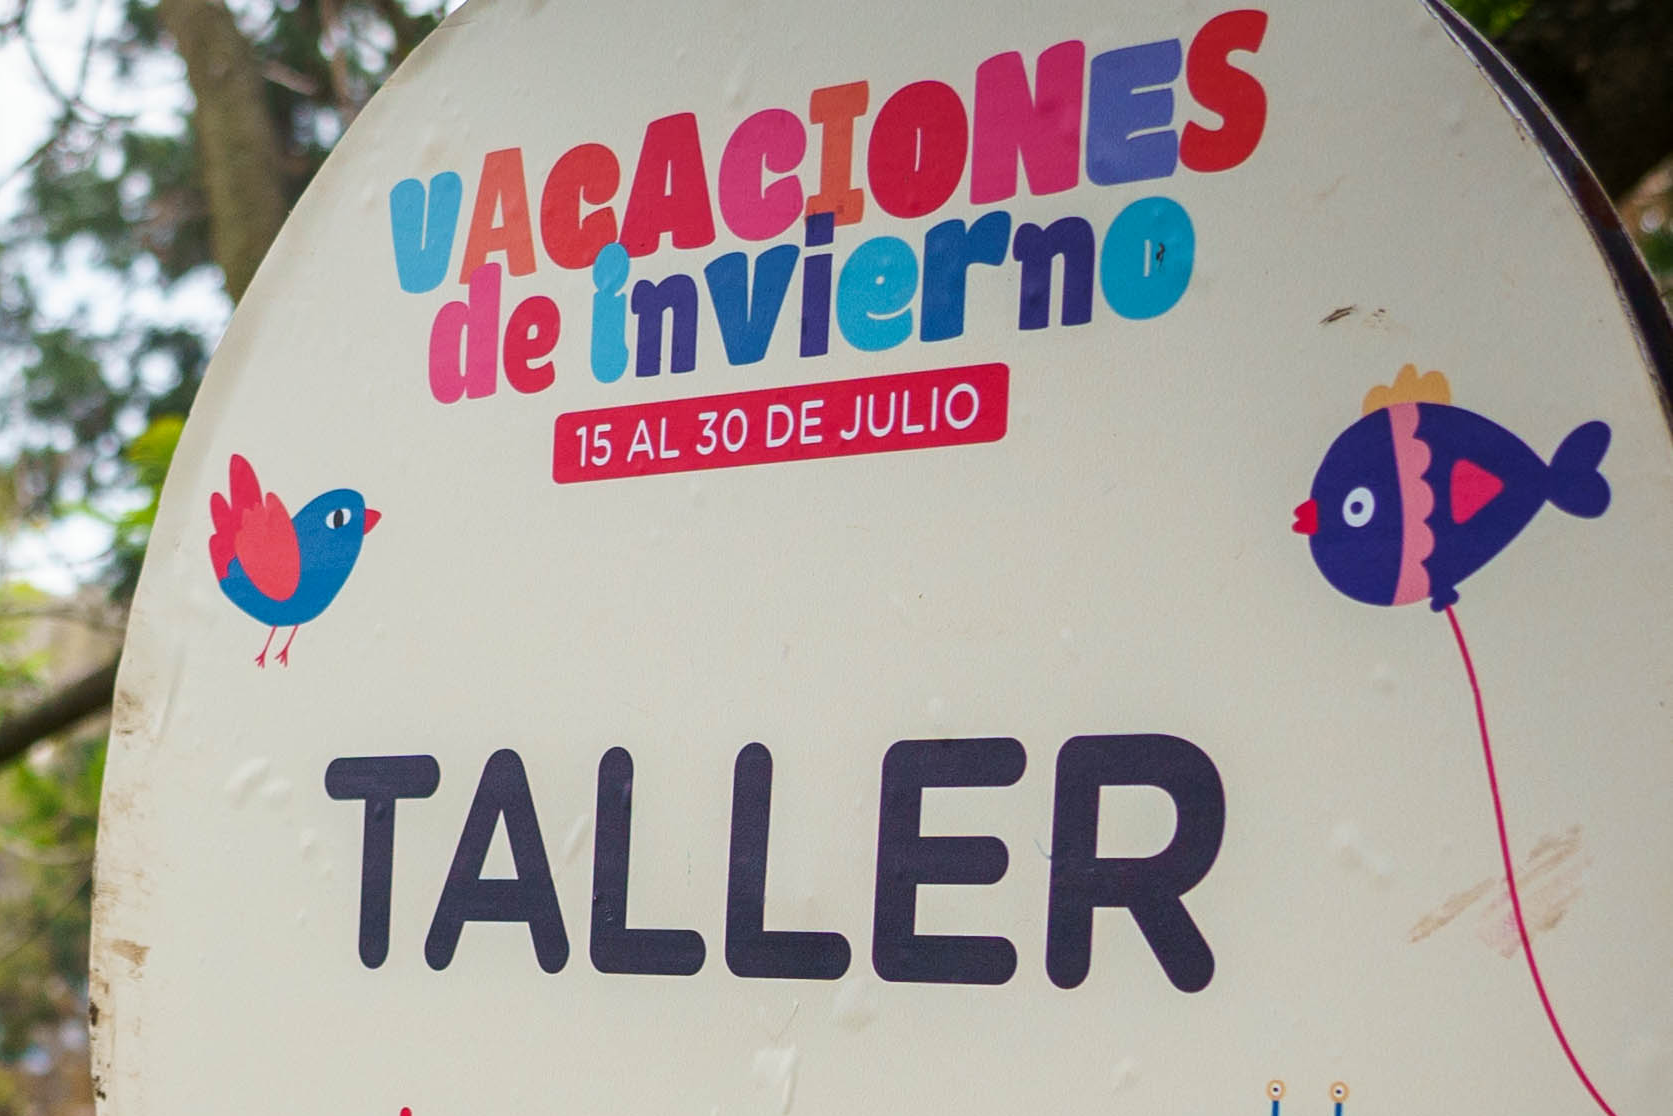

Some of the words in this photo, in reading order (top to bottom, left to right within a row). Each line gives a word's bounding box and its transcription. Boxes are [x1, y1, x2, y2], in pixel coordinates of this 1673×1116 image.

[390, 9, 1268, 294] VACACIONES
[429, 262, 561, 405] de
[591, 196, 1195, 383] invierno
[576, 423, 614, 468] 15
[627, 416, 680, 461] AL
[695, 407, 749, 455] 30
[767, 400, 822, 449] DE
[839, 382, 980, 439] JULIO
[325, 733, 1226, 994] TALLER
